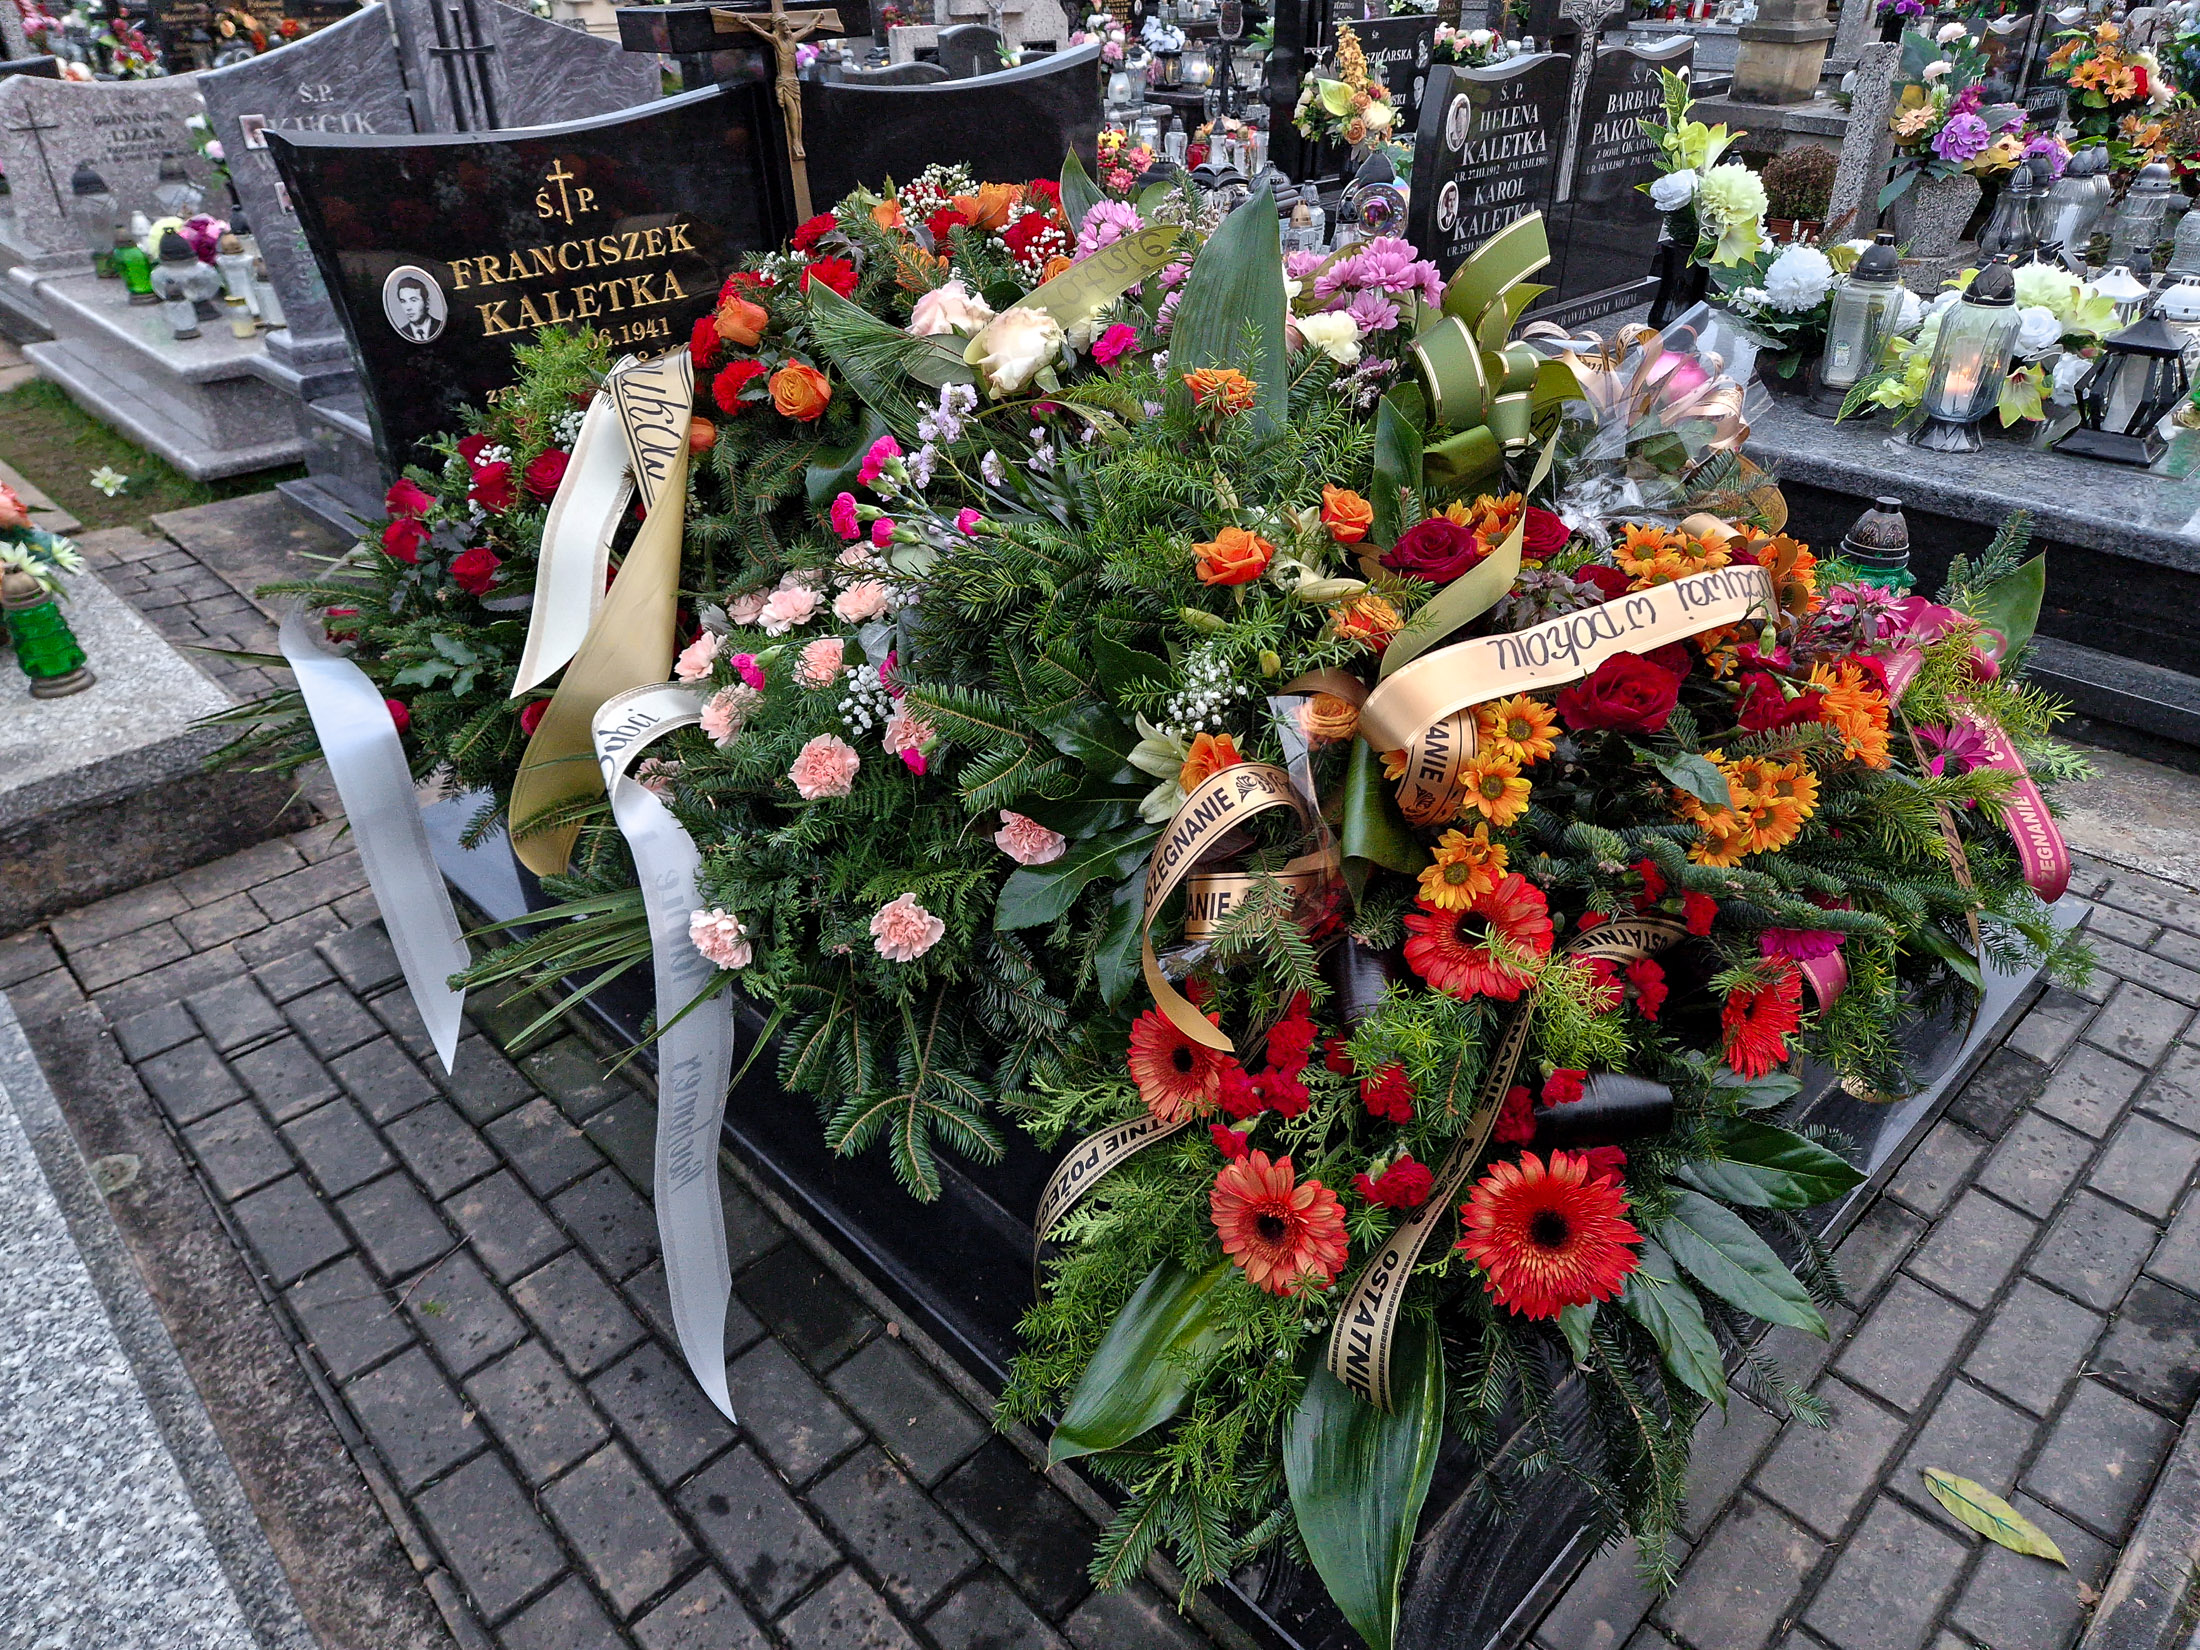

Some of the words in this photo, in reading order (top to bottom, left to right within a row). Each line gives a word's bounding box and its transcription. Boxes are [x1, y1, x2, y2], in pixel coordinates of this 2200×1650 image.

[1479, 103, 1540, 132] HELENA
[1591, 109, 1667, 146] PAKOŃSK
[1461, 129, 1548, 166] KALETKA
[535, 187, 562, 218] Ś.
[575, 187, 600, 212] P.
[1474, 177, 1526, 207] KAROL
[447, 223, 695, 291] FRANCISZEK
[475, 268, 689, 337] KALETKA
[1102, 1118, 1166, 1156] TNIE
